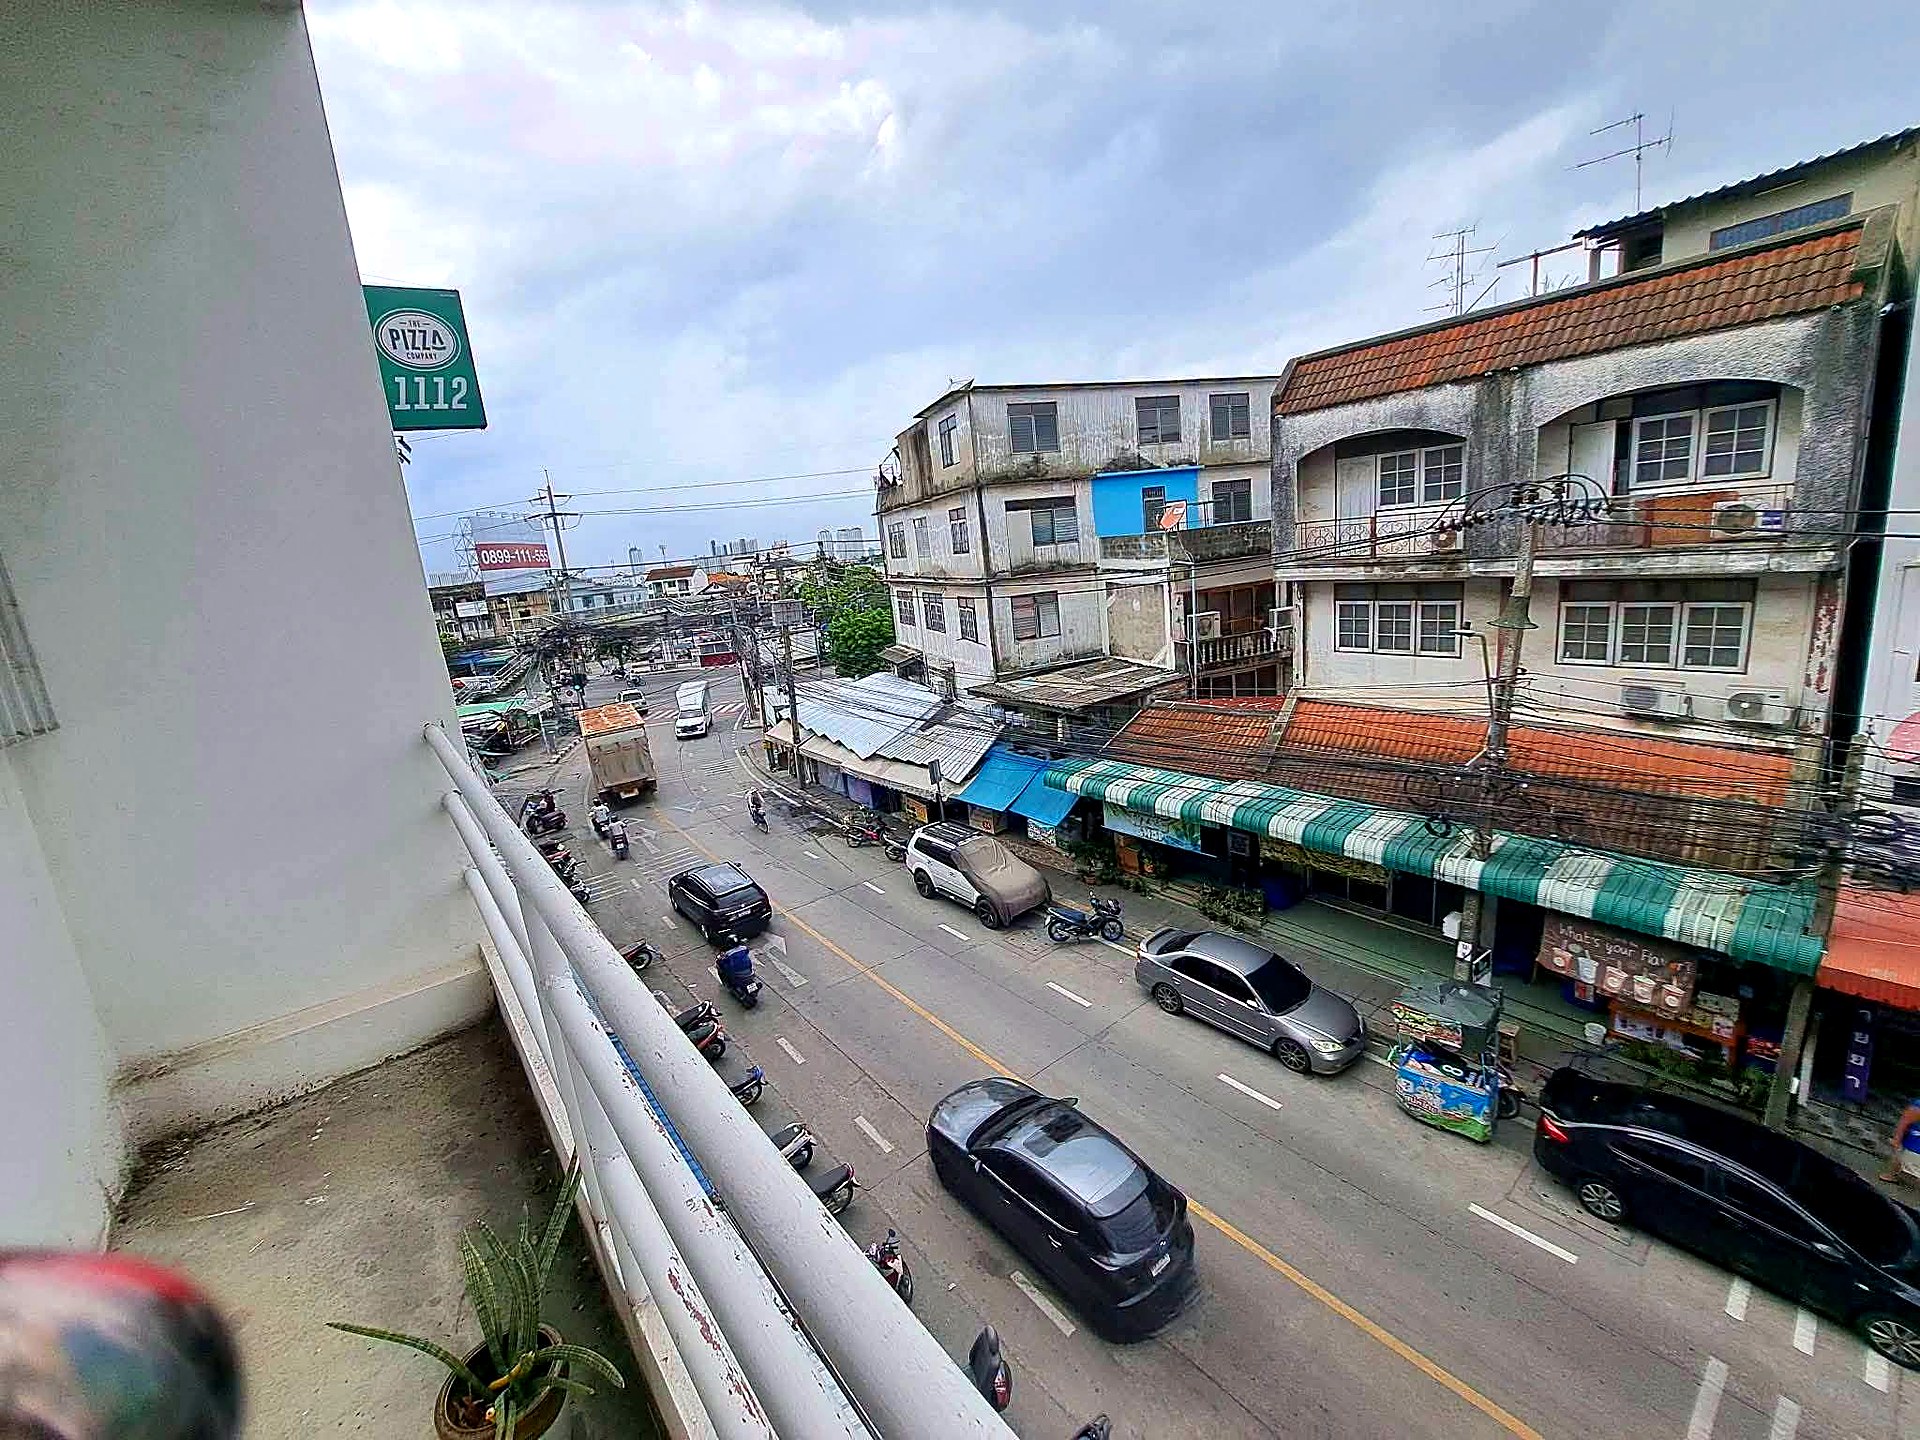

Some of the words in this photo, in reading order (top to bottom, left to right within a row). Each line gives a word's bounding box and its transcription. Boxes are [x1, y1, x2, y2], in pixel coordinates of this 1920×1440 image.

[408, 320, 421, 328] THE
[388, 328, 447, 351] PIZZA
[406, 352, 438, 360] COMPANY
[394, 376, 468, 410] 1112
[481, 549, 549, 565] 0899-111-555
[1605, 942, 1636, 958] your
